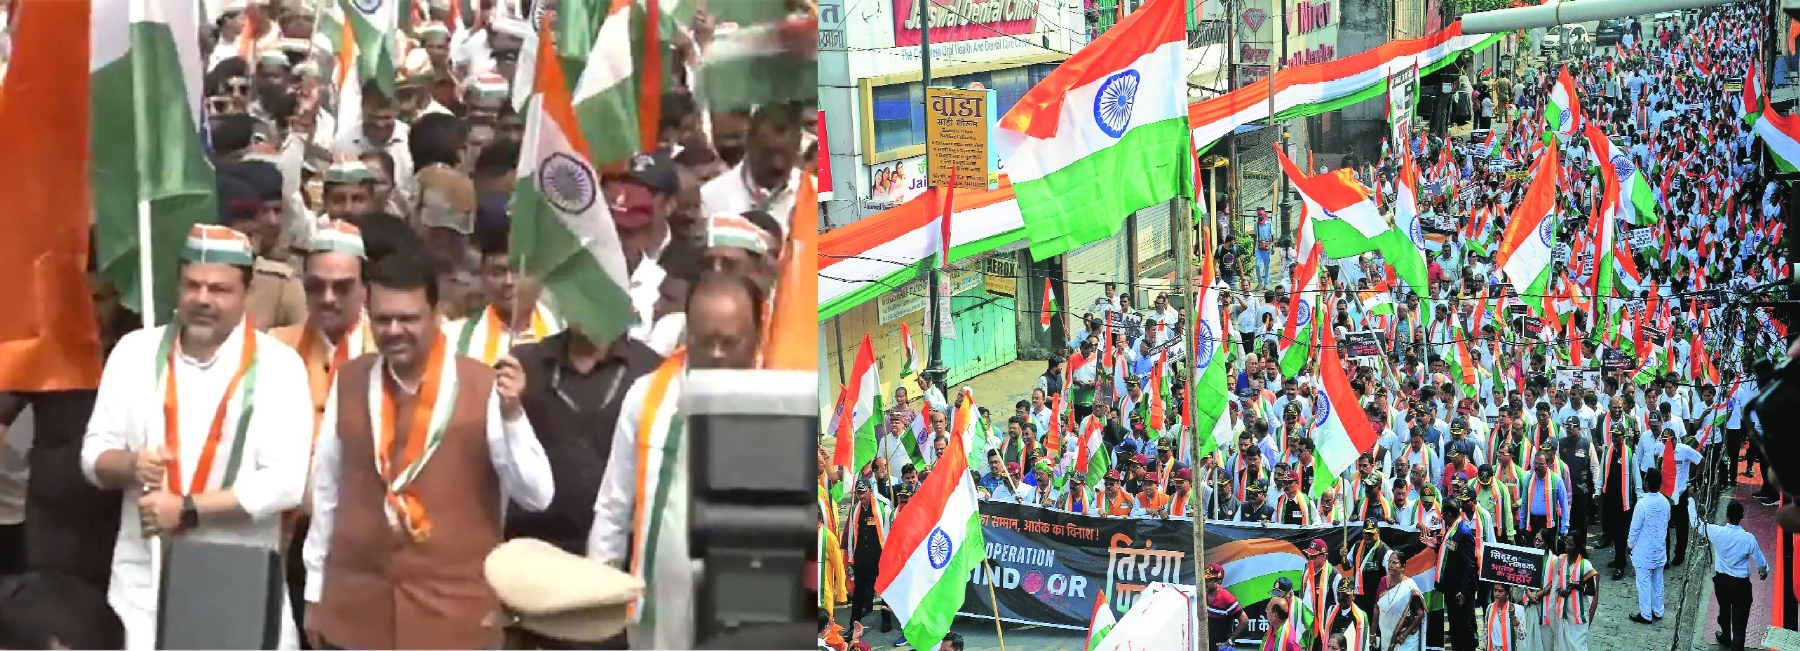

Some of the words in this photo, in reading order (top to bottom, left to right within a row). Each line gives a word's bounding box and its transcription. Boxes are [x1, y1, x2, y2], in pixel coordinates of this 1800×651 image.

[958, 0, 1003, 26] Dental
[1002, 0, 1038, 21] Clinic
[901, 48, 913, 61] The
[913, 47, 941, 60] Colete
[942, 45, 954, 57] Oral
[955, 43, 973, 56] Health
[973, 42, 984, 53] And
[985, 40, 1001, 52] Dental
[1003, 38, 1014, 49] Care
[931, 96, 983, 117] वाडा
[1023, 519, 1050, 535] आतंक
[1052, 523, 1065, 536] का
[985, 542, 1055, 568] OPERATION
[967, 562, 1088, 599] INDOOR
[1105, 532, 1185, 605] तिरंगा
